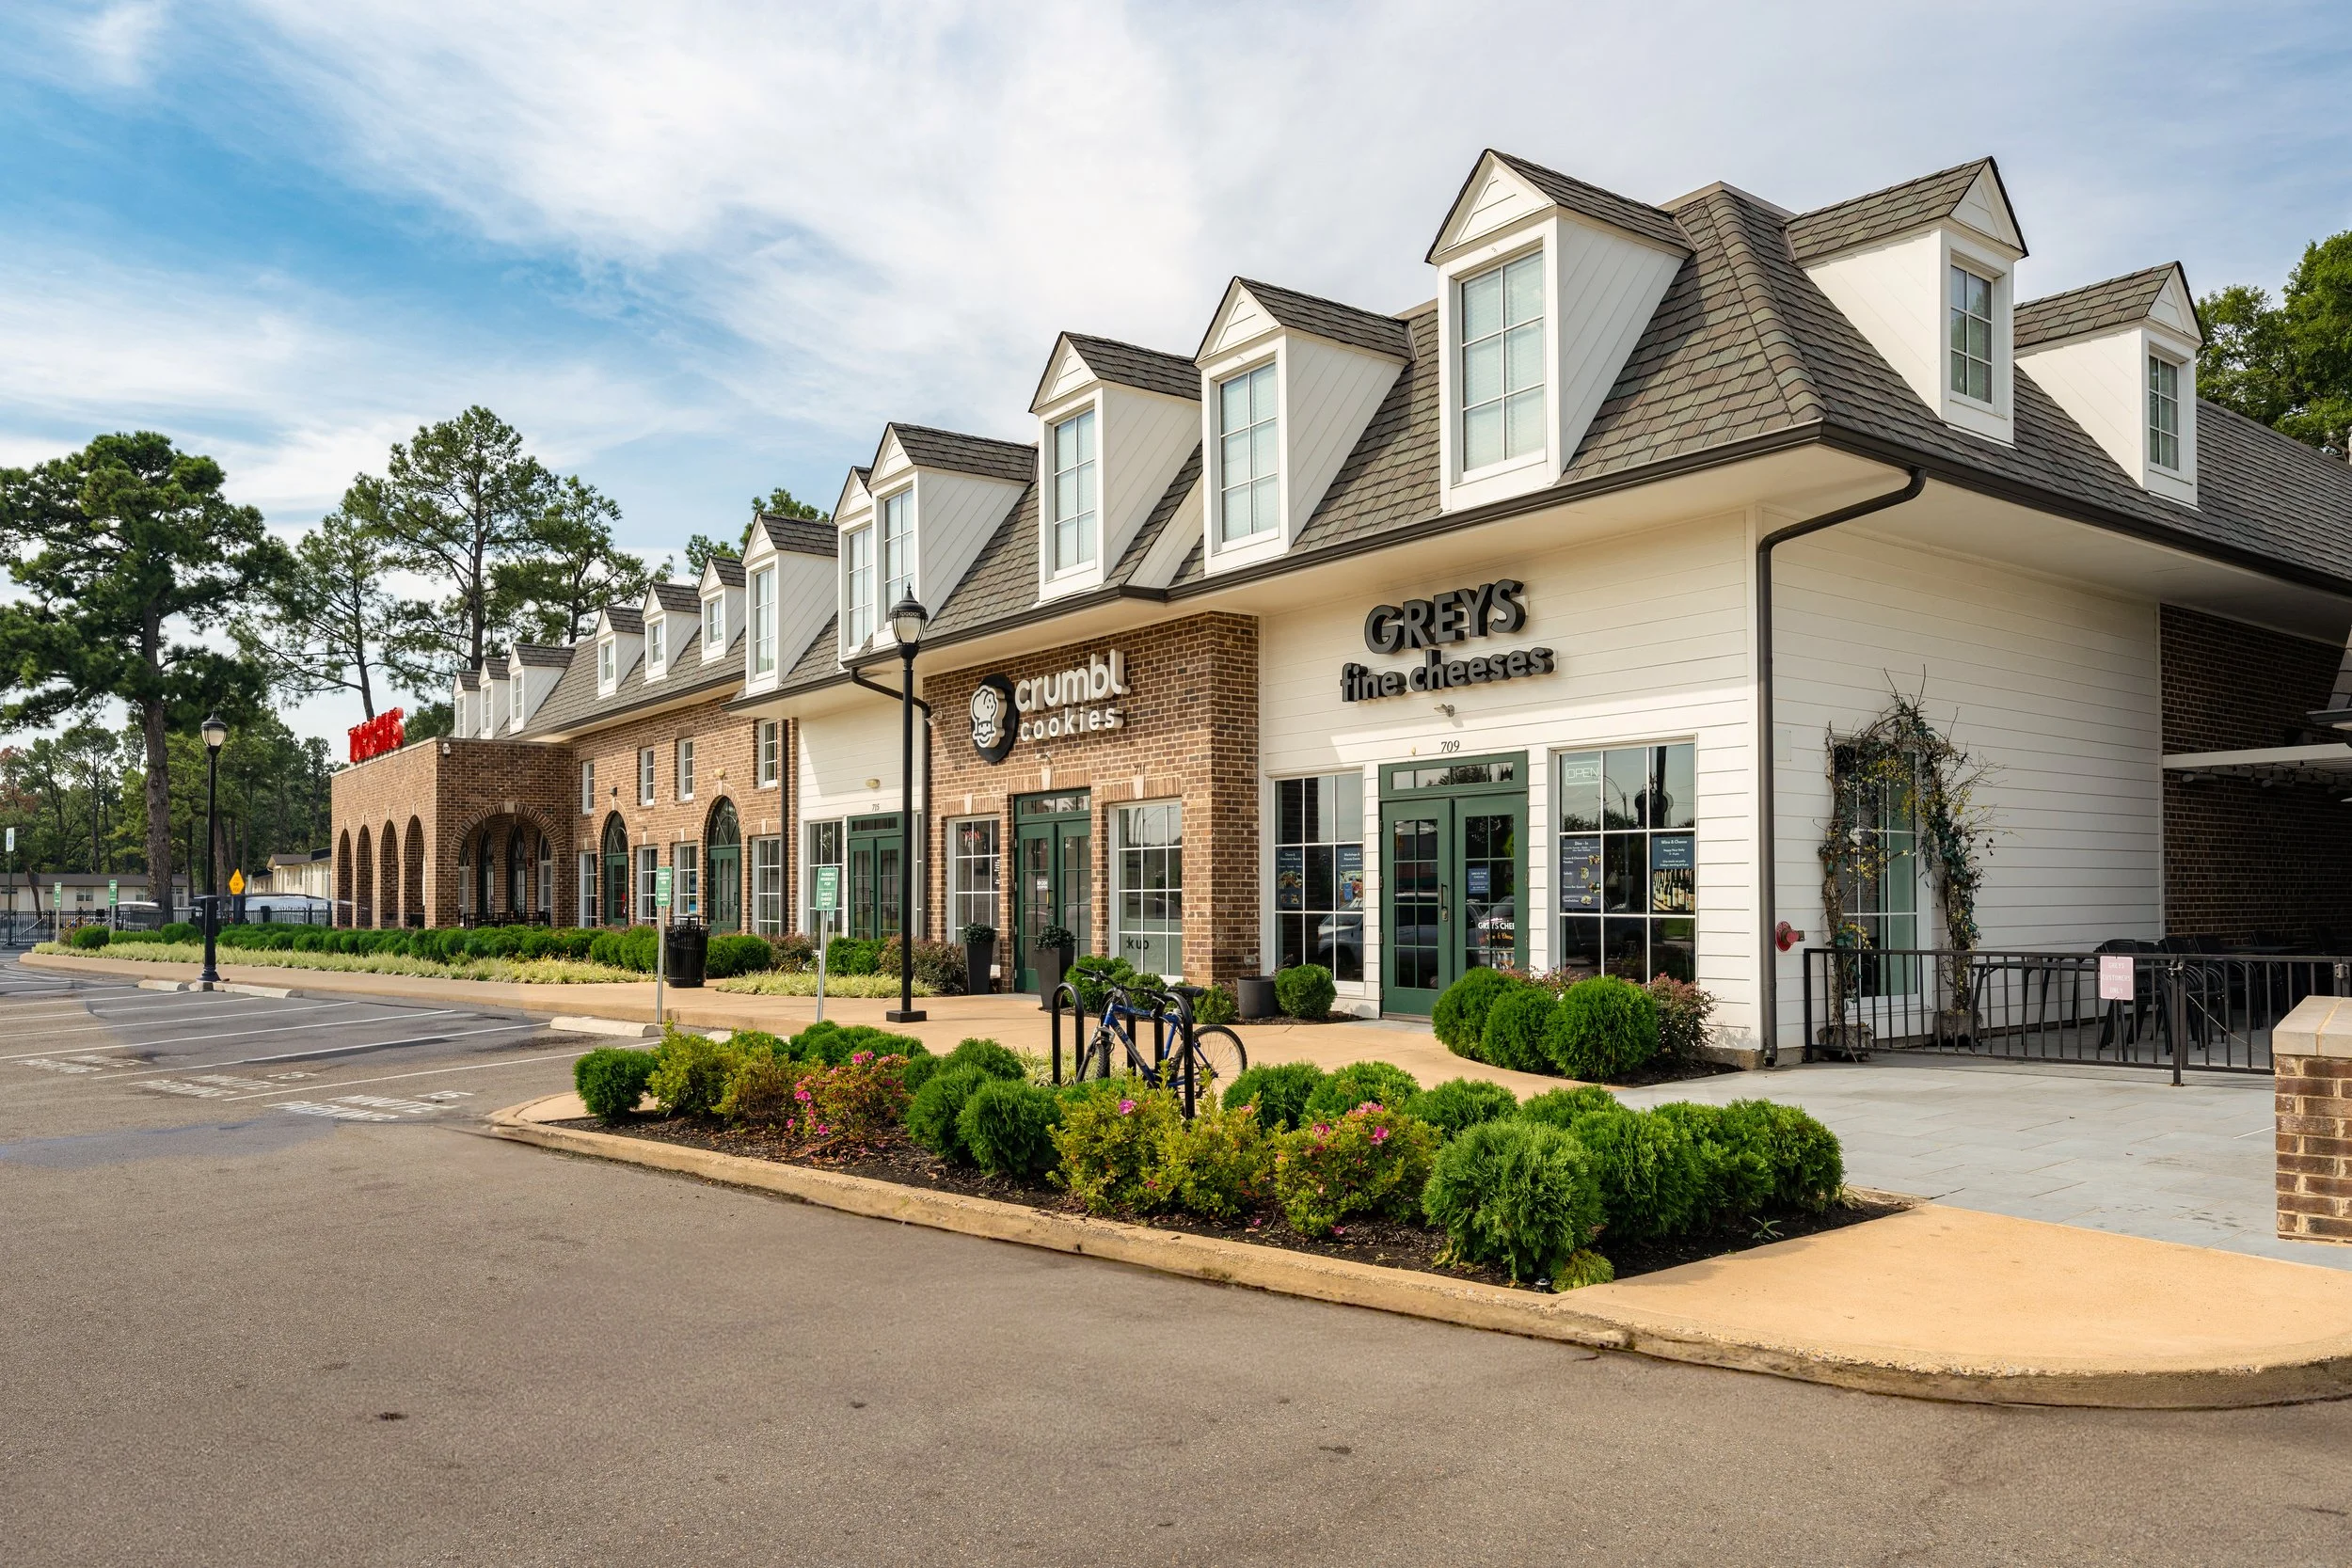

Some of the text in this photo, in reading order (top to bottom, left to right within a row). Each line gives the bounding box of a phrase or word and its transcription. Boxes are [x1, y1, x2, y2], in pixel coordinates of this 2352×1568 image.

[1364, 578, 1526, 654] GREYS
[1015, 648, 1131, 713] crumbl
[1341, 647, 1554, 702] fine cheeses
[1021, 706, 1123, 742] cookies
[1441, 740, 1459, 753] 709
[1566, 768, 1598, 780] OPEN
[2102, 974, 2131, 982] CUSTOMERS
